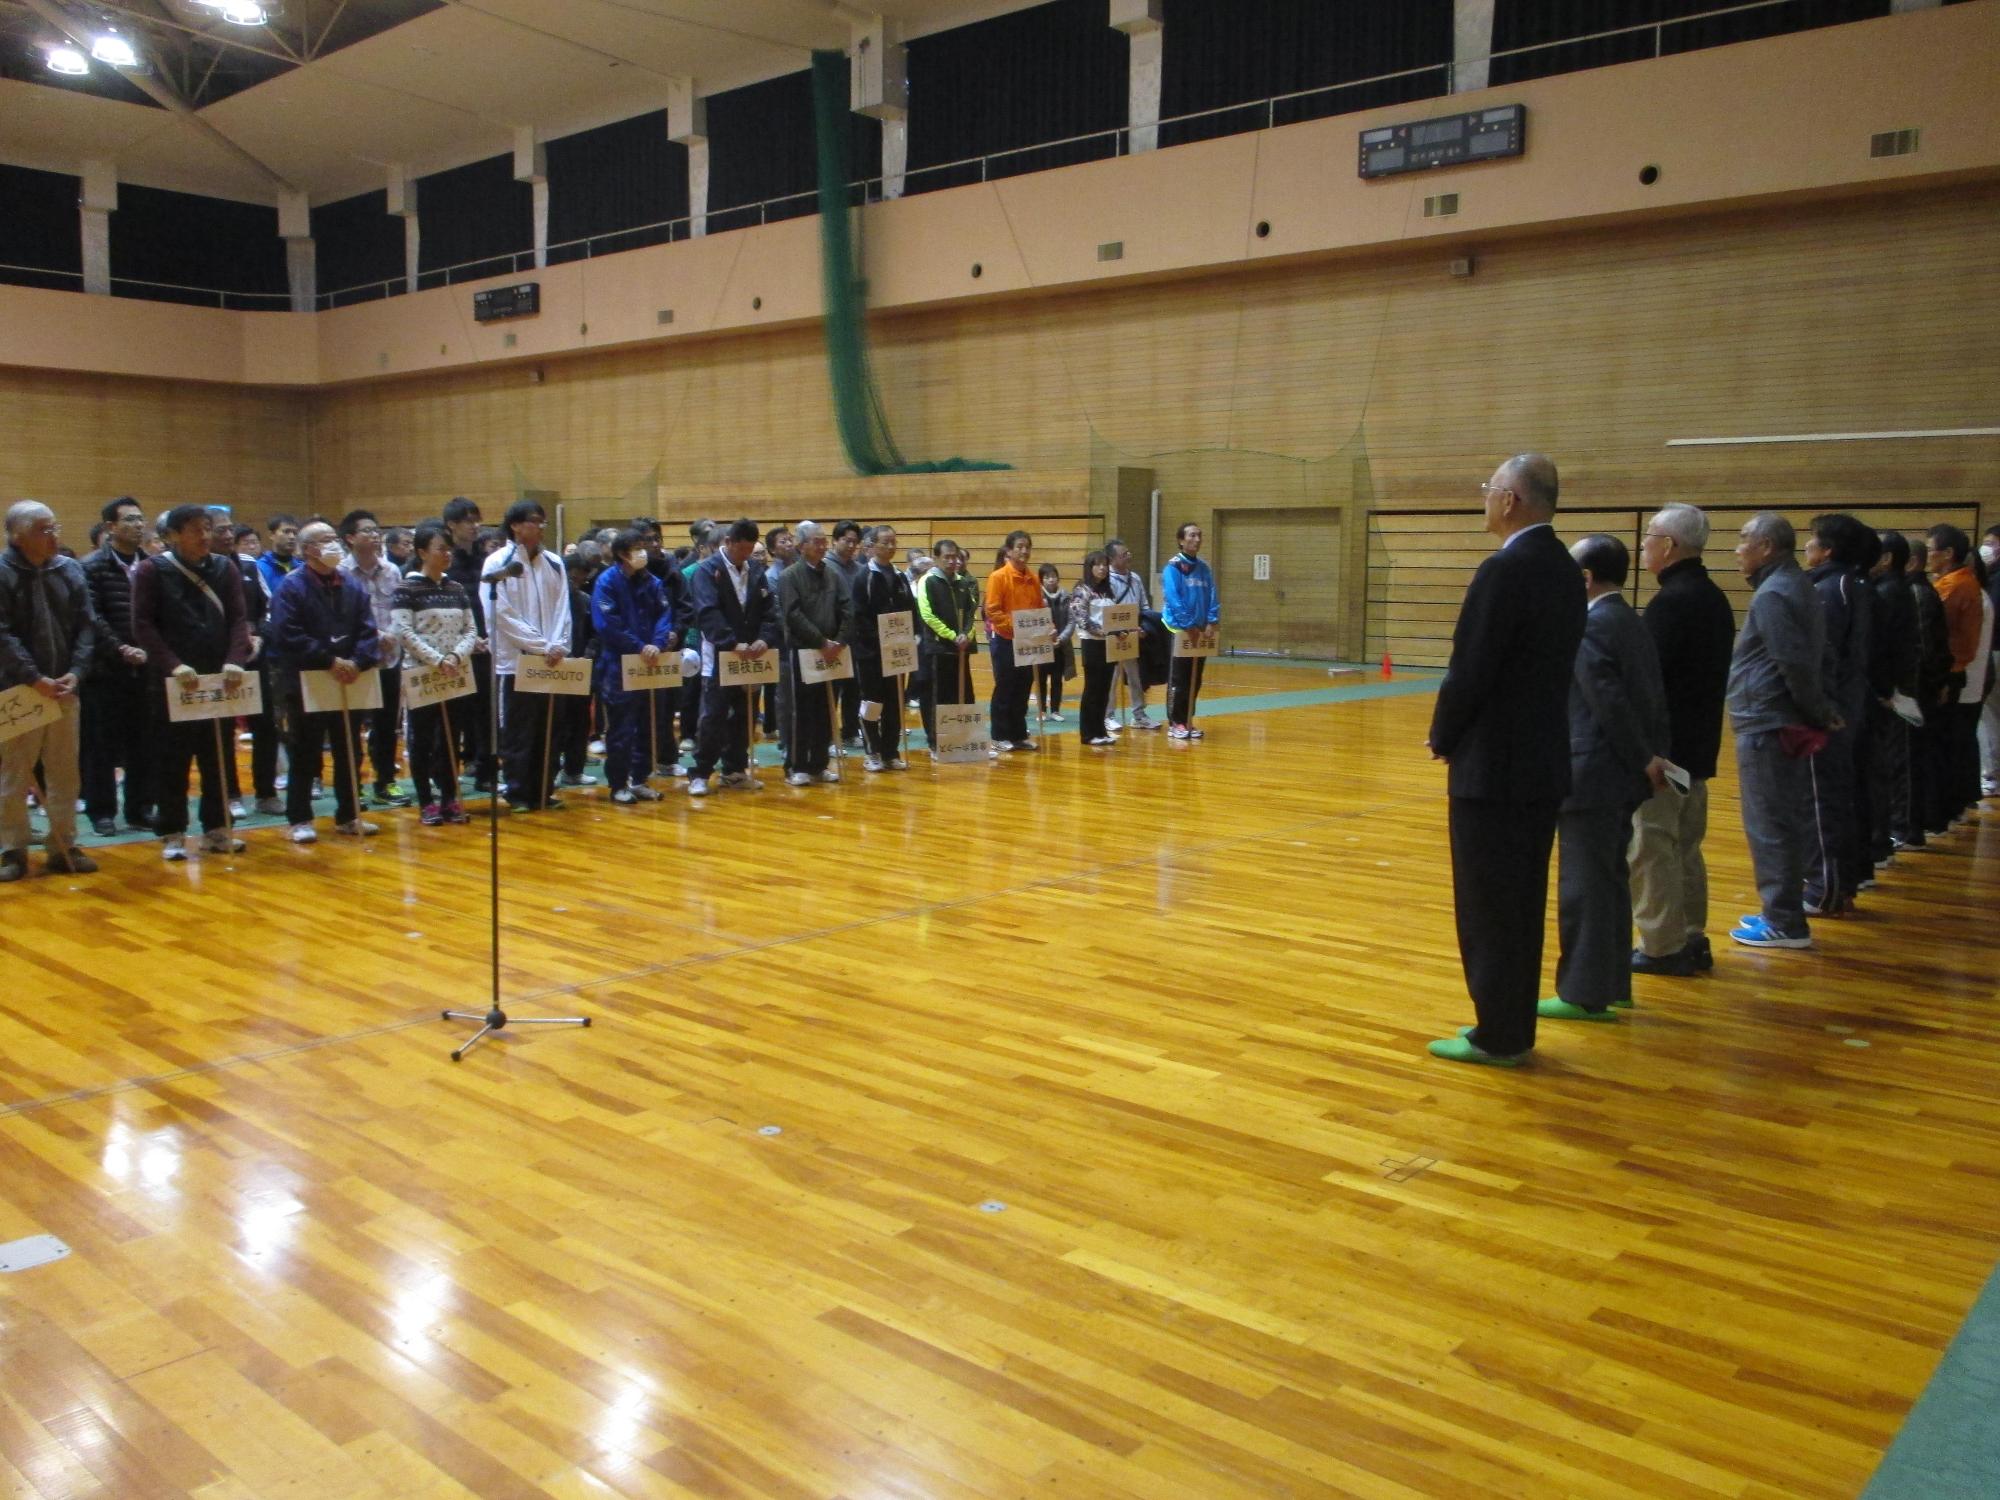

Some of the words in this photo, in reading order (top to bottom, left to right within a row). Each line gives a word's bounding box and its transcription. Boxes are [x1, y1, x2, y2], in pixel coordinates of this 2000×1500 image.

[728, 659, 773, 674] 稲枝西A
[526, 668, 585, 681] SHIROUTO
